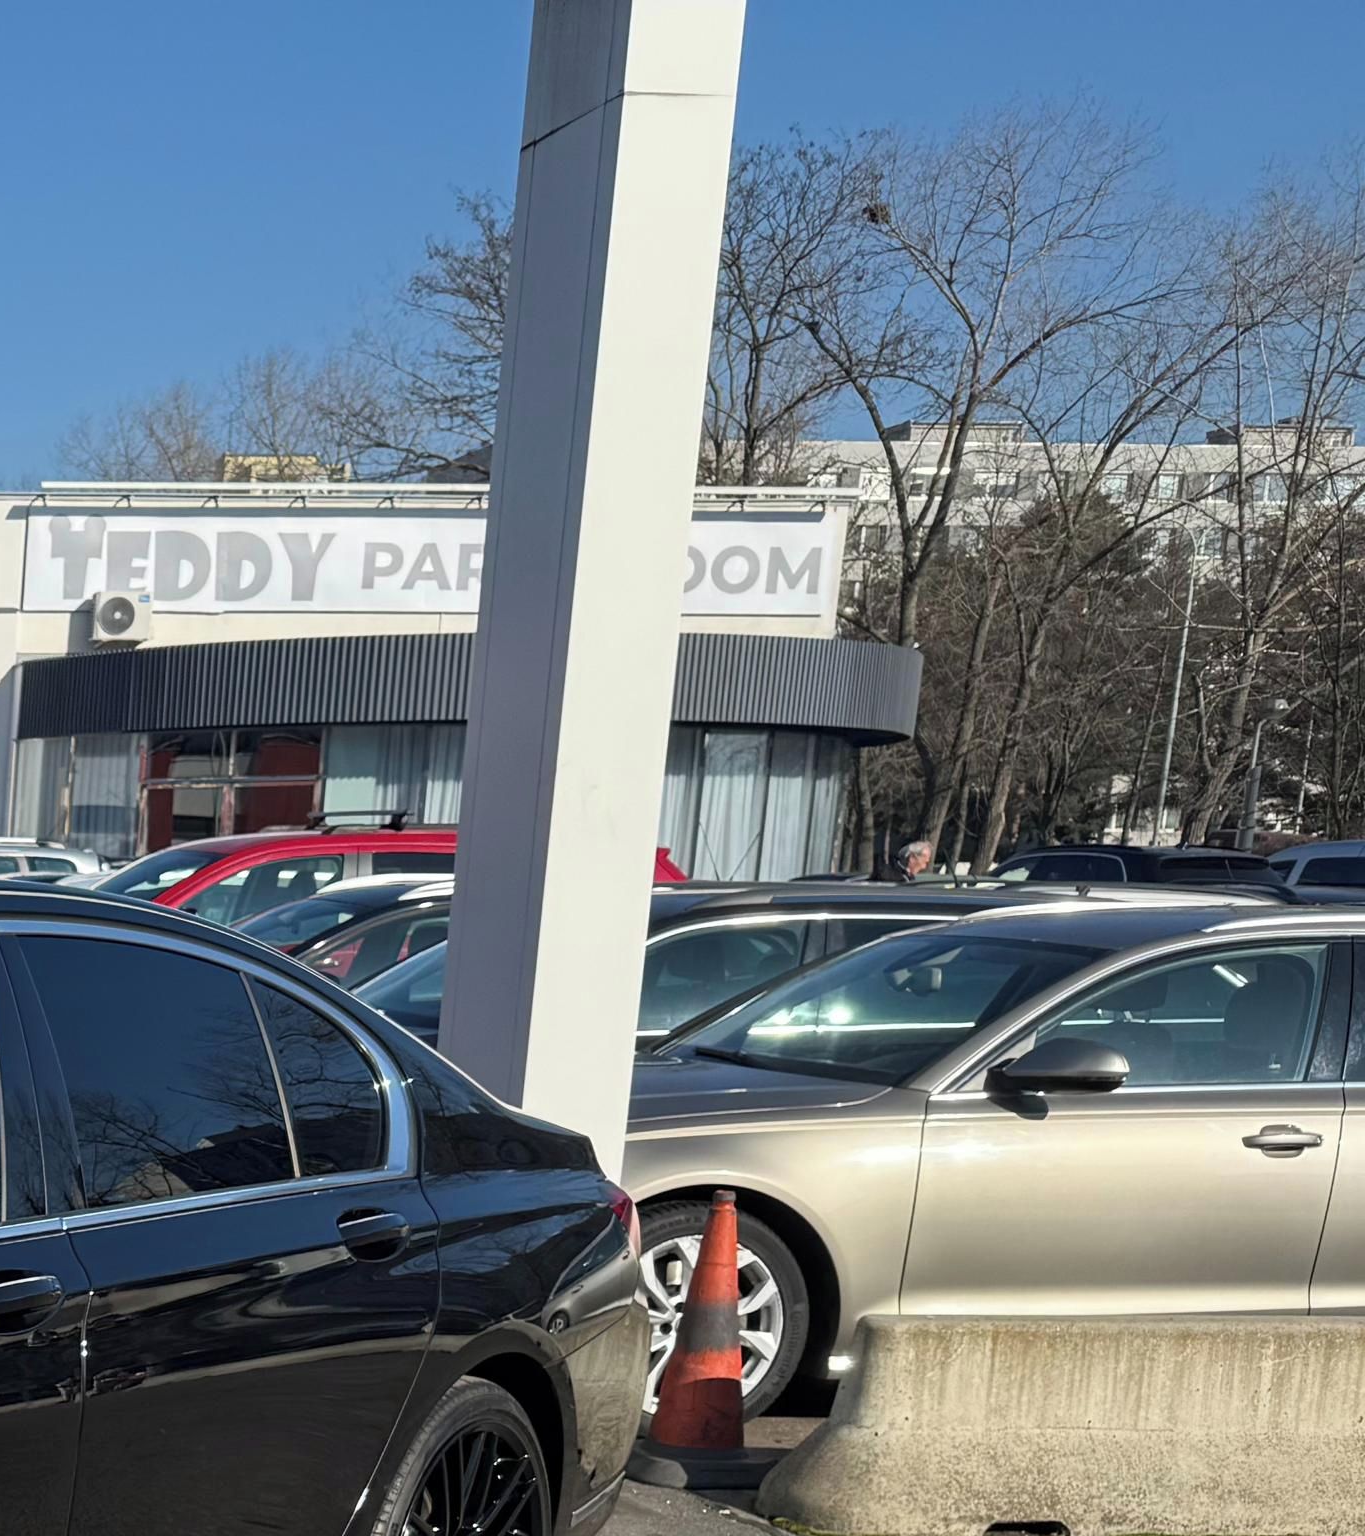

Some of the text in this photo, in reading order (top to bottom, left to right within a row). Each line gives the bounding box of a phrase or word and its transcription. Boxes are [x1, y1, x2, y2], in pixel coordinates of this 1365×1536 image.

[49, 513, 822, 601] TEDDY PAR OM
